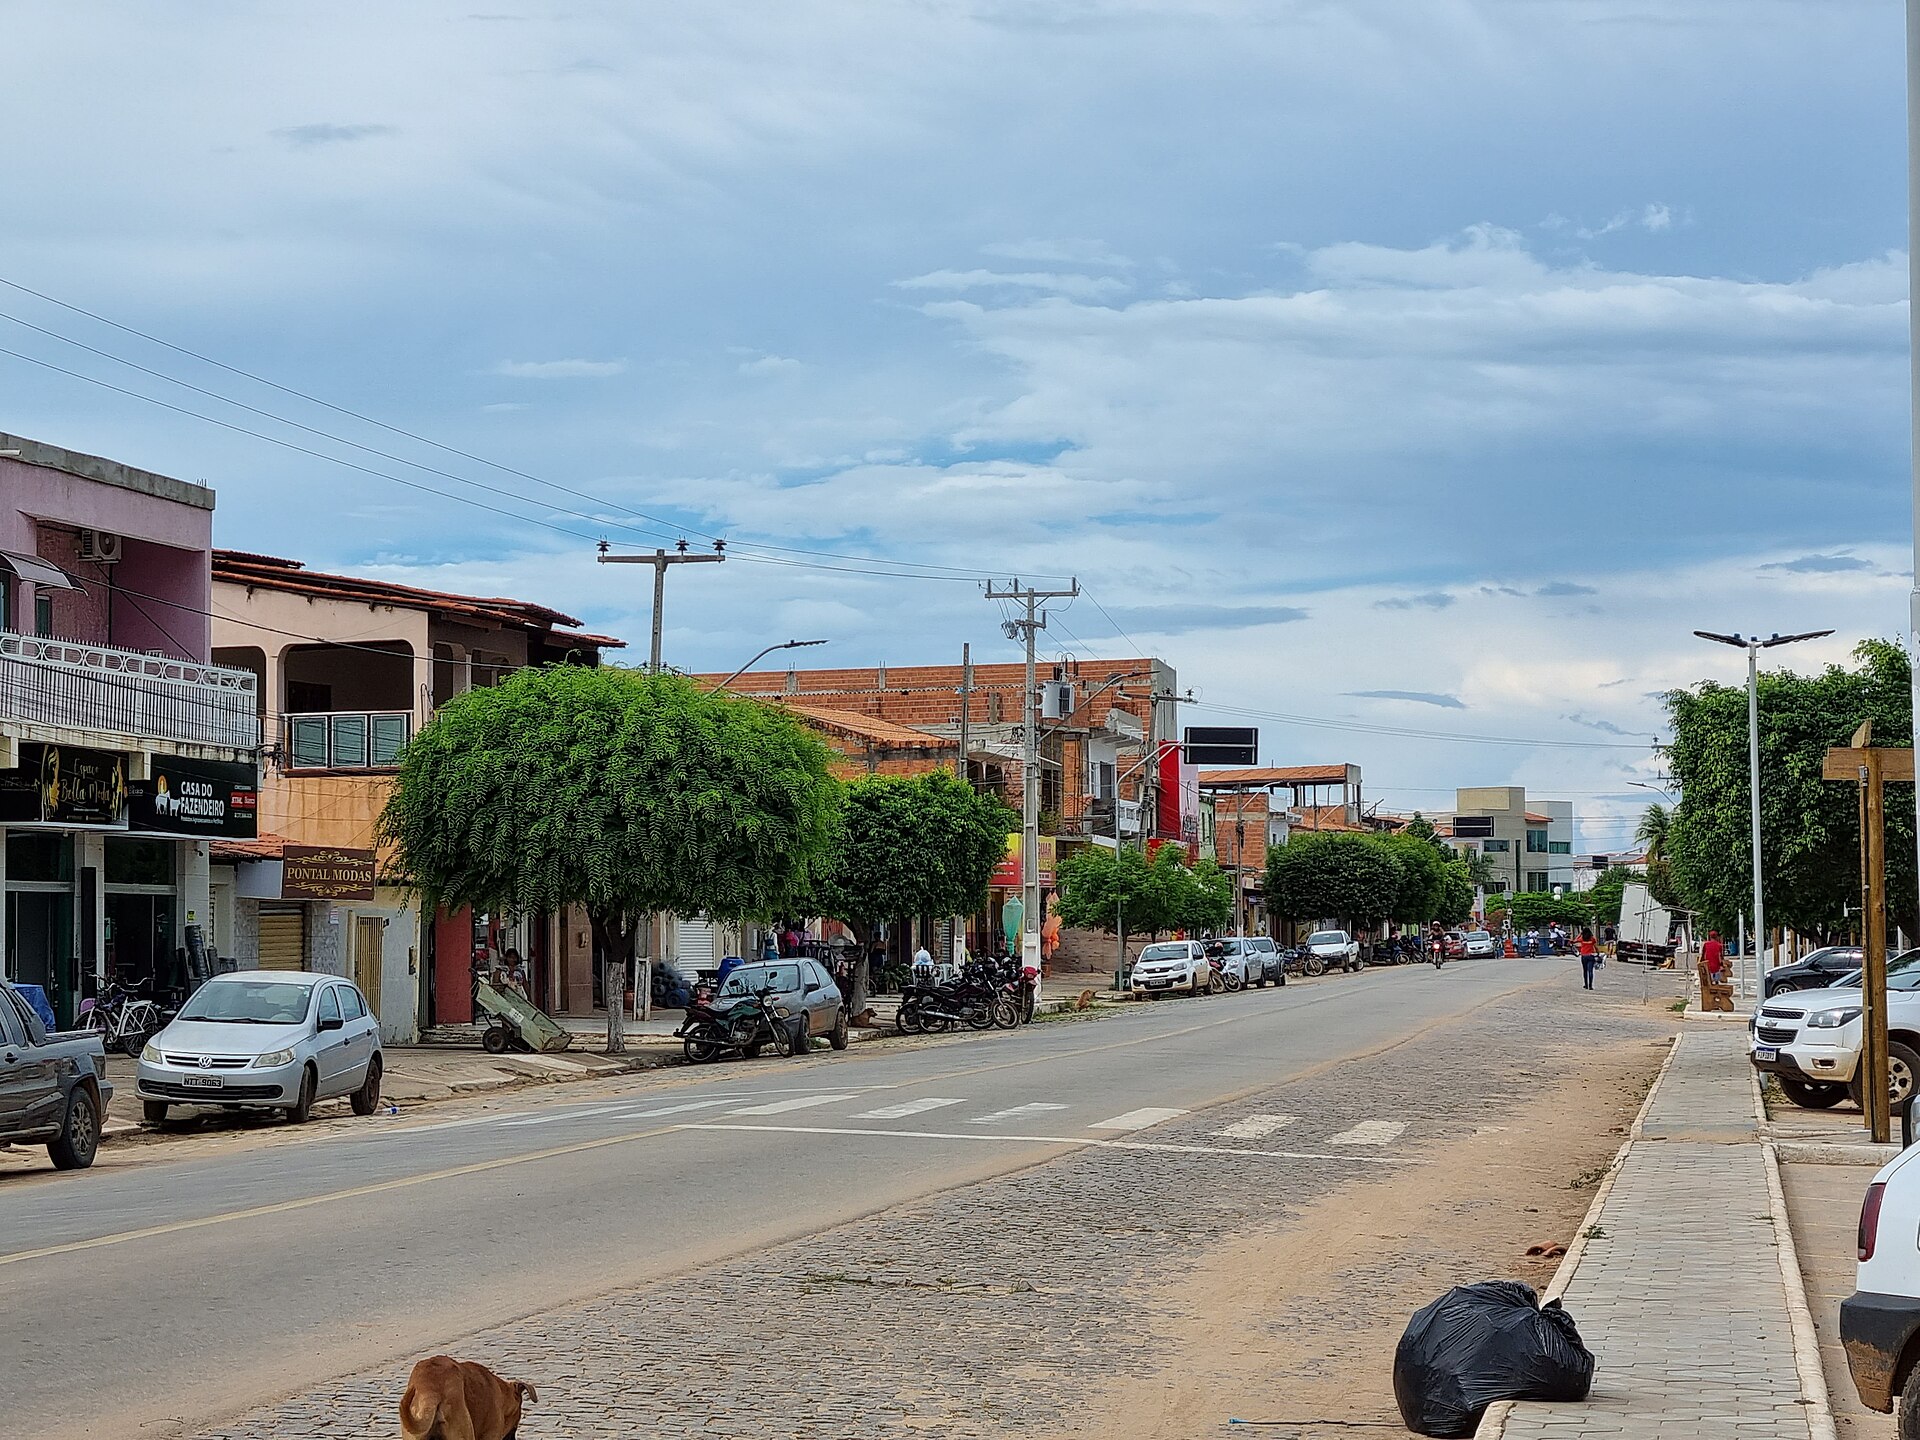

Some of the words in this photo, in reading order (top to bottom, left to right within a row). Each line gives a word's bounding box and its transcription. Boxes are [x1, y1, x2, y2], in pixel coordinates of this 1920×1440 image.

[181, 781, 200, 796] CASA
[201, 783, 213, 797] DO
[181, 797, 224, 817] FAZENDEIRO
[287, 867, 330, 880] PONTAL
[332, 869, 371, 882] MODAS
